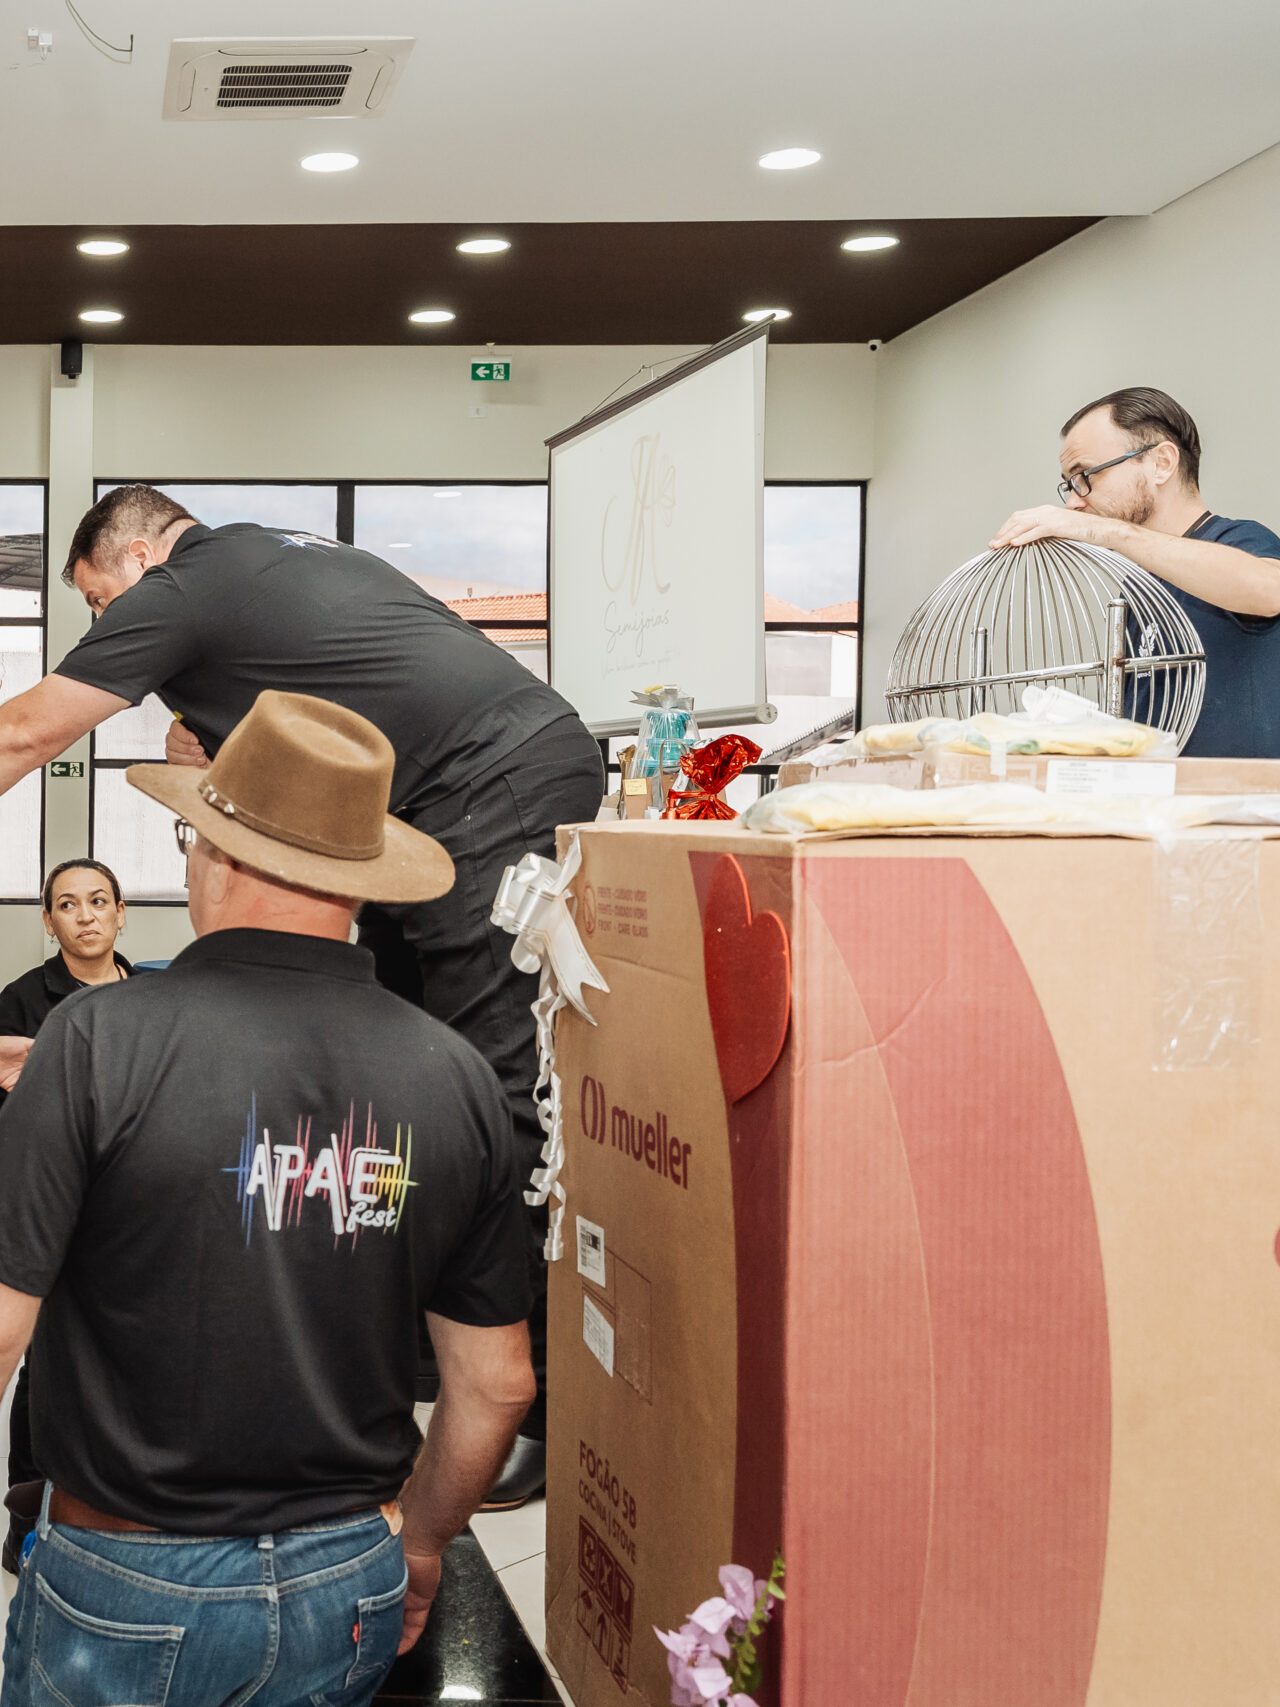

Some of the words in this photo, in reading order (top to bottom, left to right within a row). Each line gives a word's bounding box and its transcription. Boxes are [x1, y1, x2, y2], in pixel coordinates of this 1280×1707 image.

[245, 1127, 402, 1236] APAE
[611, 1105, 692, 1190] mueller
[345, 1201, 398, 1233] fest
[580, 1439, 620, 1508] FOGÃO
